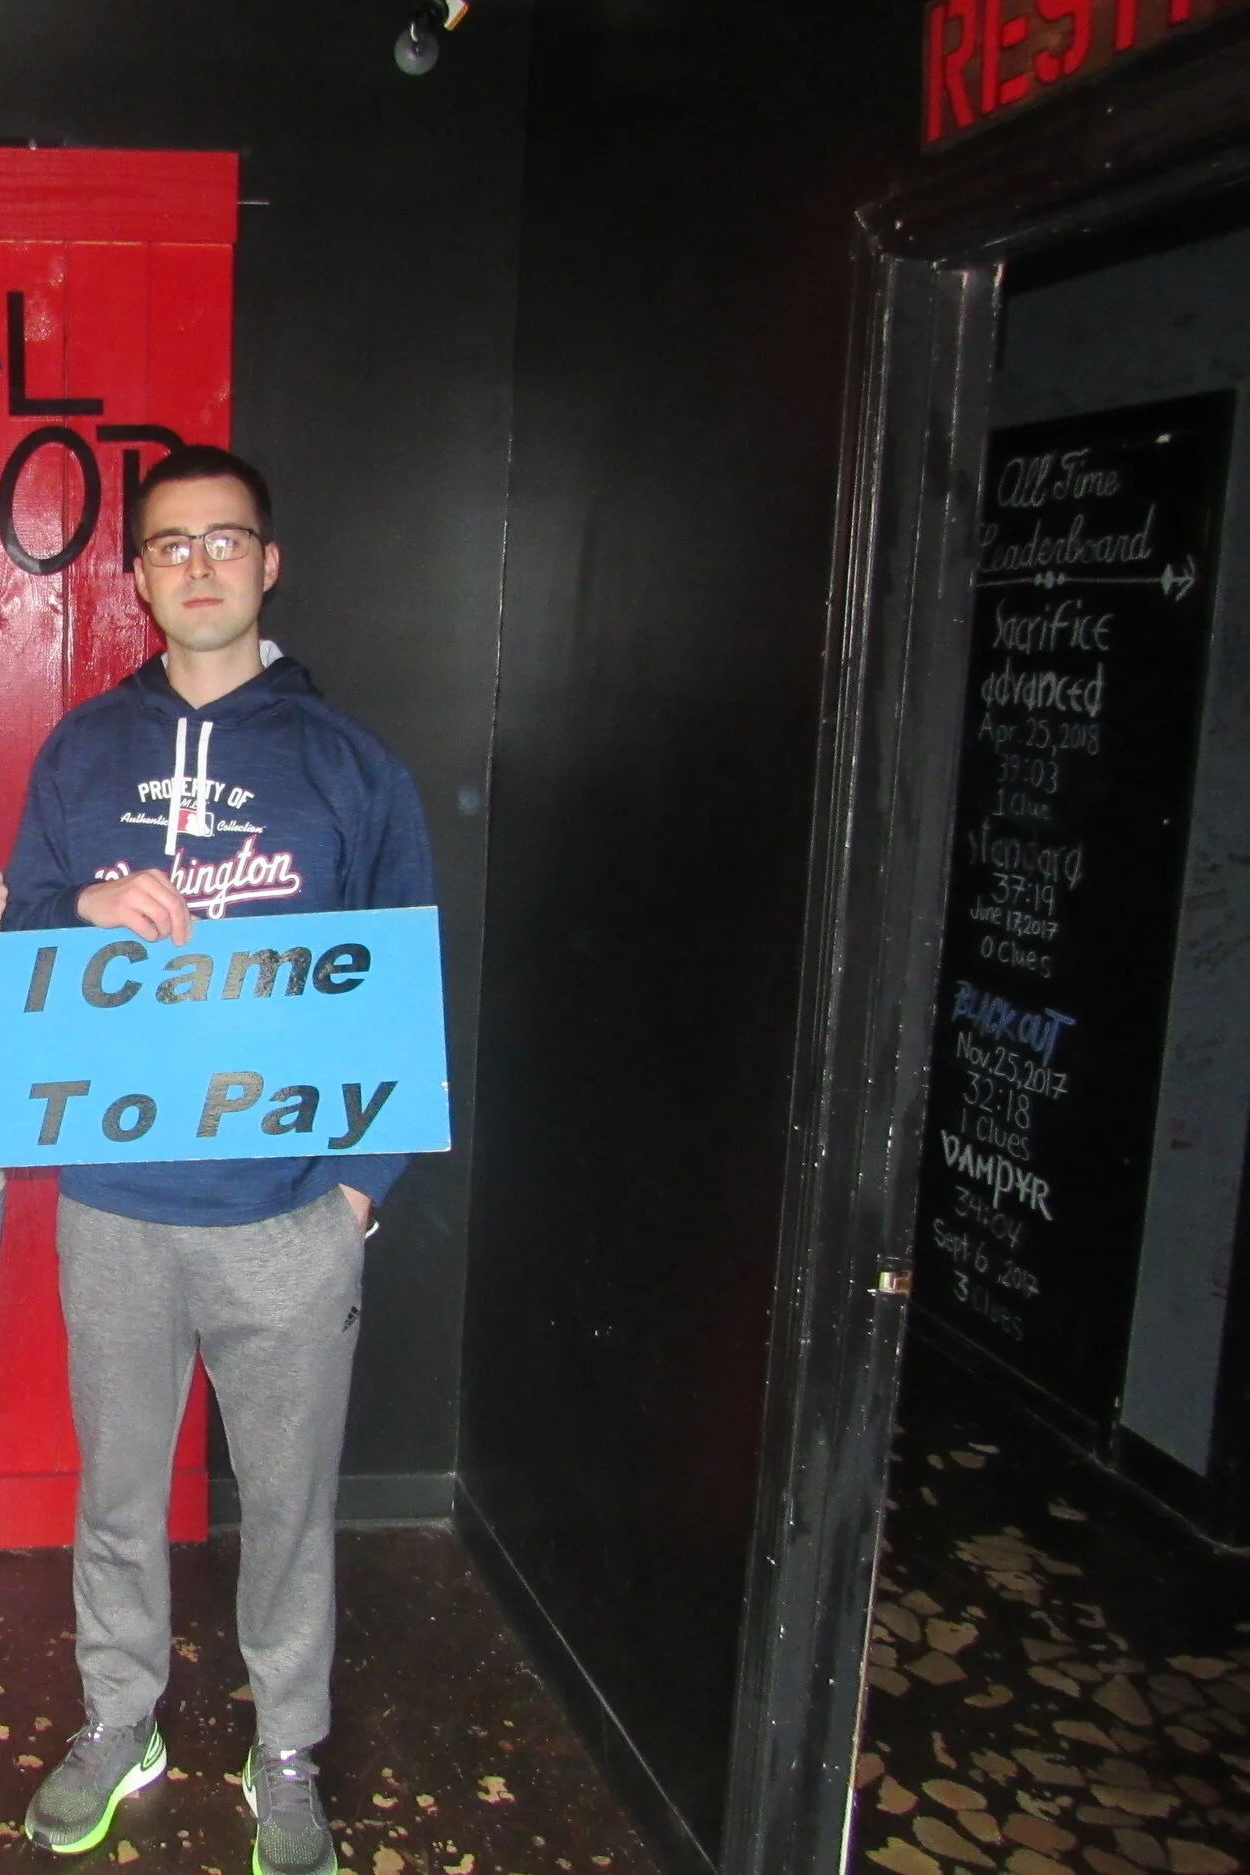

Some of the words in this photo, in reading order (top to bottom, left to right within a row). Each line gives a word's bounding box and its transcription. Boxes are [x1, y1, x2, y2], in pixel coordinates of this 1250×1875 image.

[997, 453, 1055, 508] All
[1053, 448, 1121, 500] Time
[977, 501, 1156, 573] Leaderboard
[997, 752, 1058, 794] 39:03
[227, 787, 254, 809] OF
[216, 820, 265, 833] Collection
[969, 896, 1002, 925] June
[990, 871, 1056, 915] 37:19
[24, 946, 58, 1013] I
[81, 940, 372, 1009] Came
[999, 940, 1051, 980] Clues
[29, 1080, 158, 1146] To
[196, 1071, 398, 1150] Pay
[963, 1070, 1030, 1129] 32:18
[953, 1269, 970, 1303] 3
